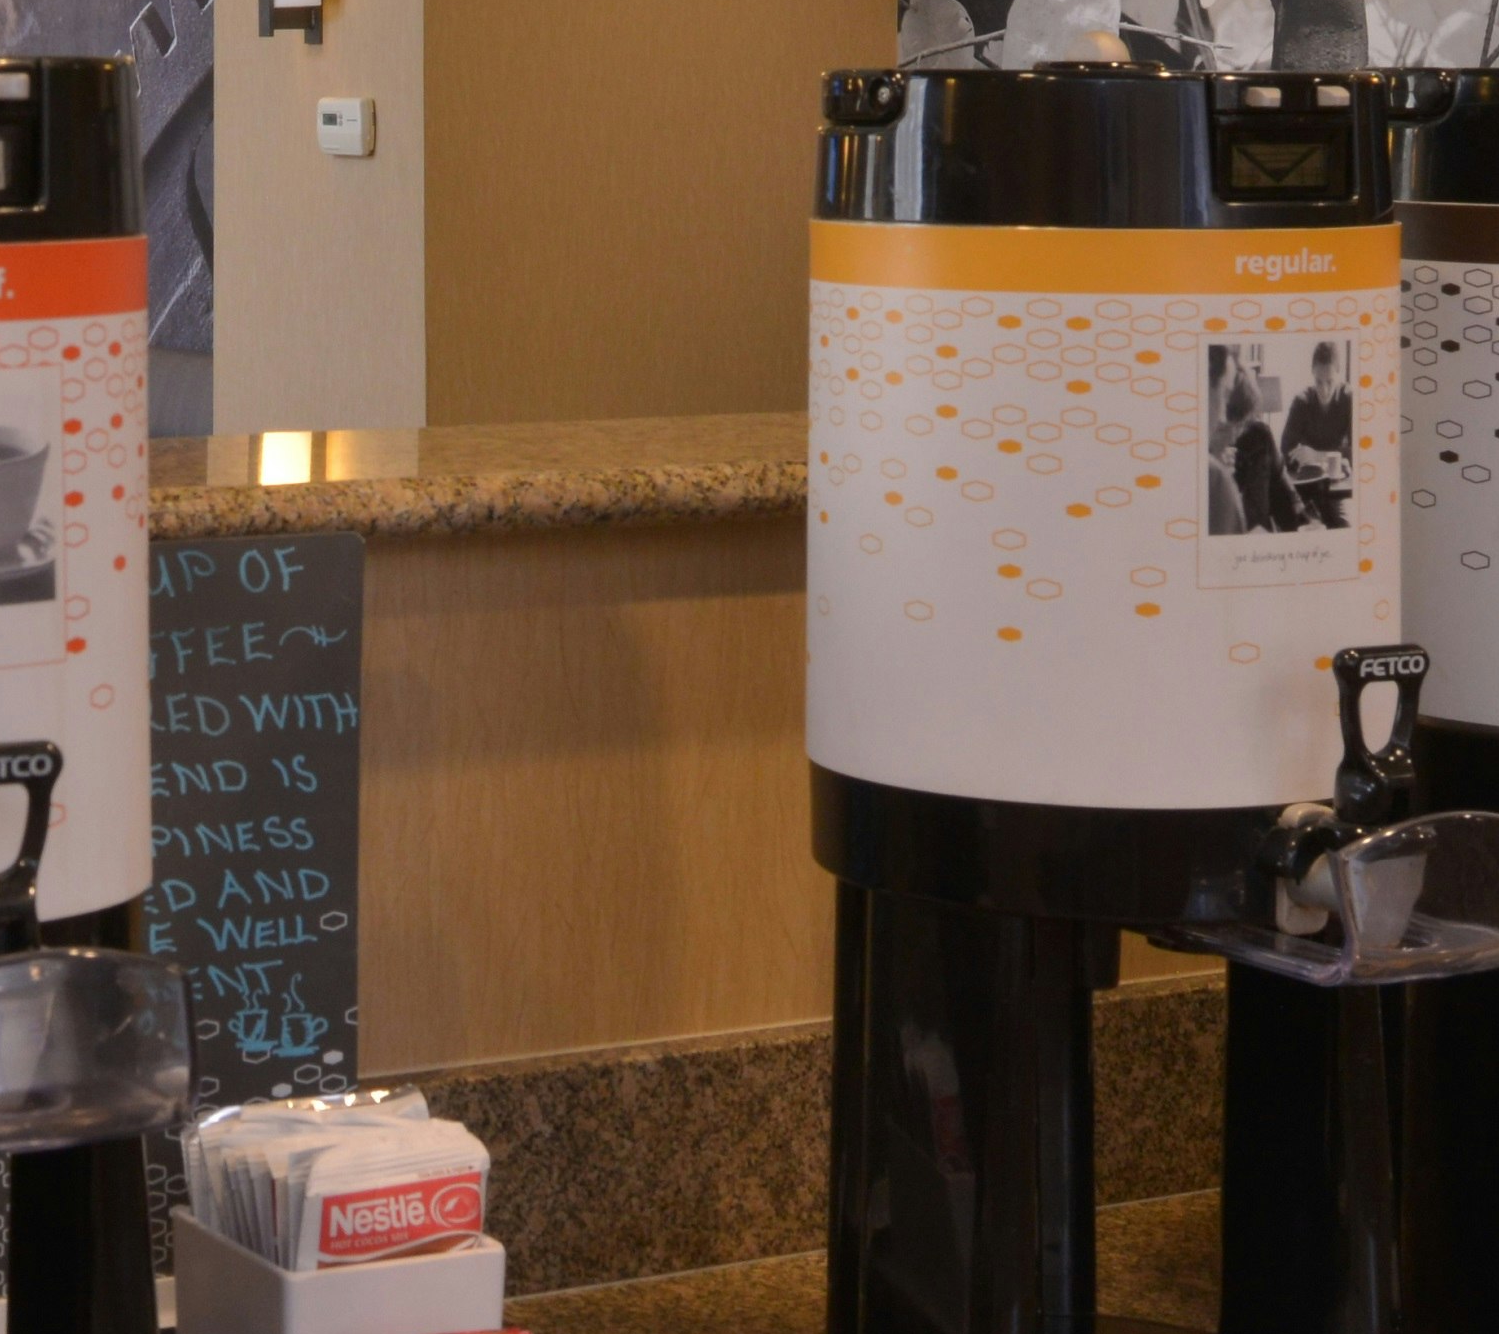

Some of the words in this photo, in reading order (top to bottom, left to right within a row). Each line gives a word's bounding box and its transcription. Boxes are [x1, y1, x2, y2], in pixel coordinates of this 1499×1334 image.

[1235, 247, 1337, 282] regular.
[239, 546, 304, 593] OF
[1360, 655, 1425, 678] FETCO
[238, 692, 358, 735] WITH
[151, 816, 314, 858] PINESS
[217, 868, 330, 909] AND
[196, 915, 318, 952] WELL
